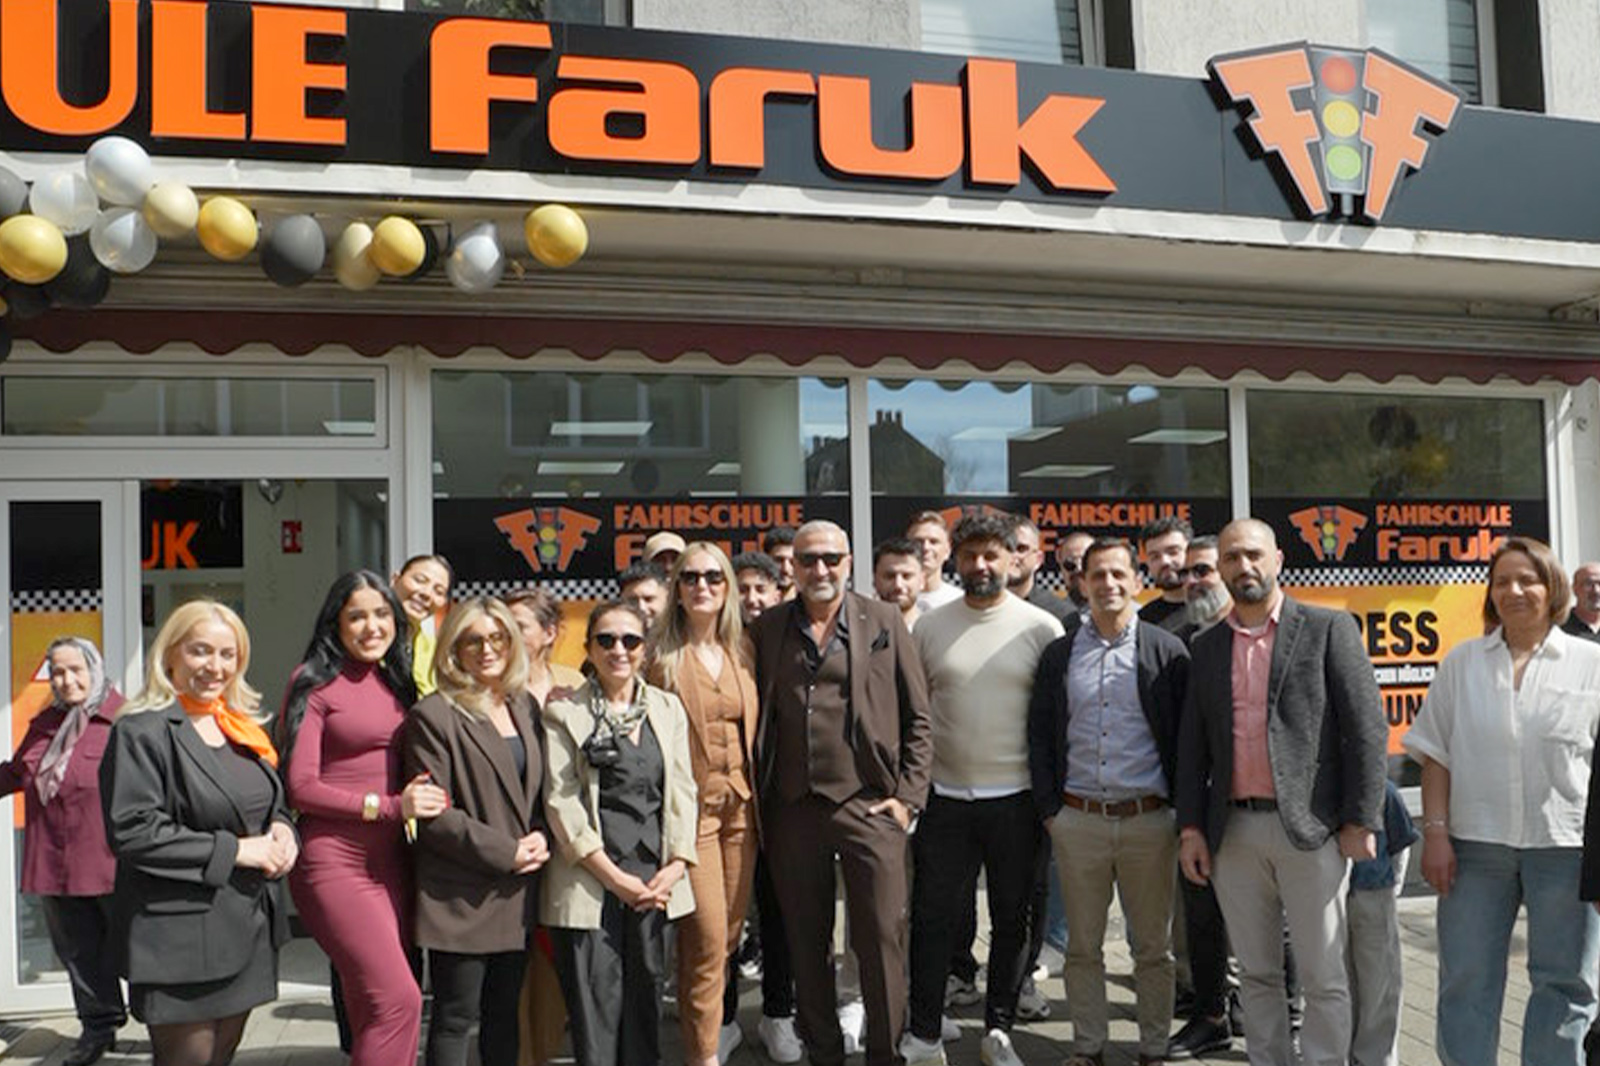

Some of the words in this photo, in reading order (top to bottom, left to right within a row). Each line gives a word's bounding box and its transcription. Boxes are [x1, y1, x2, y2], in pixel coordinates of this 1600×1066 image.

[0, 0, 347, 145] ULE
[430, 17, 1117, 193] Faruk
[614, 504, 804, 530] FAHRSCHULE
[1376, 505, 1512, 527] FAHRSCHULE
[1376, 529, 1509, 561] Faruk
[1351, 610, 1439, 657] ESS
